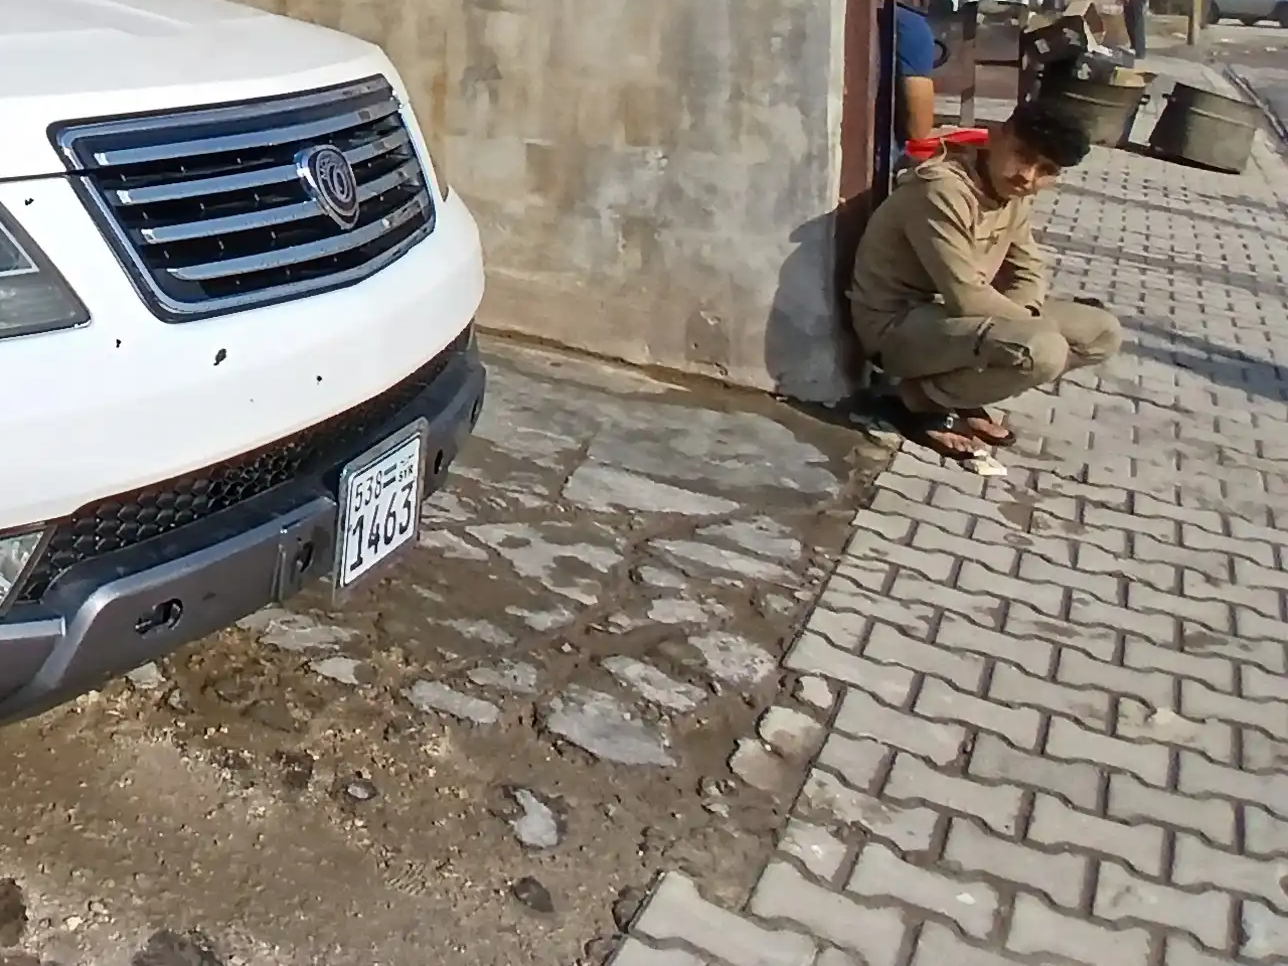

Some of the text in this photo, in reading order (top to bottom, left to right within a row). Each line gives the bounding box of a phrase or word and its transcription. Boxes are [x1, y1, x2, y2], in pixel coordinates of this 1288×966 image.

[355, 470, 382, 512] 538
[398, 465, 413, 483] SYR
[350, 480, 415, 571] 1463
